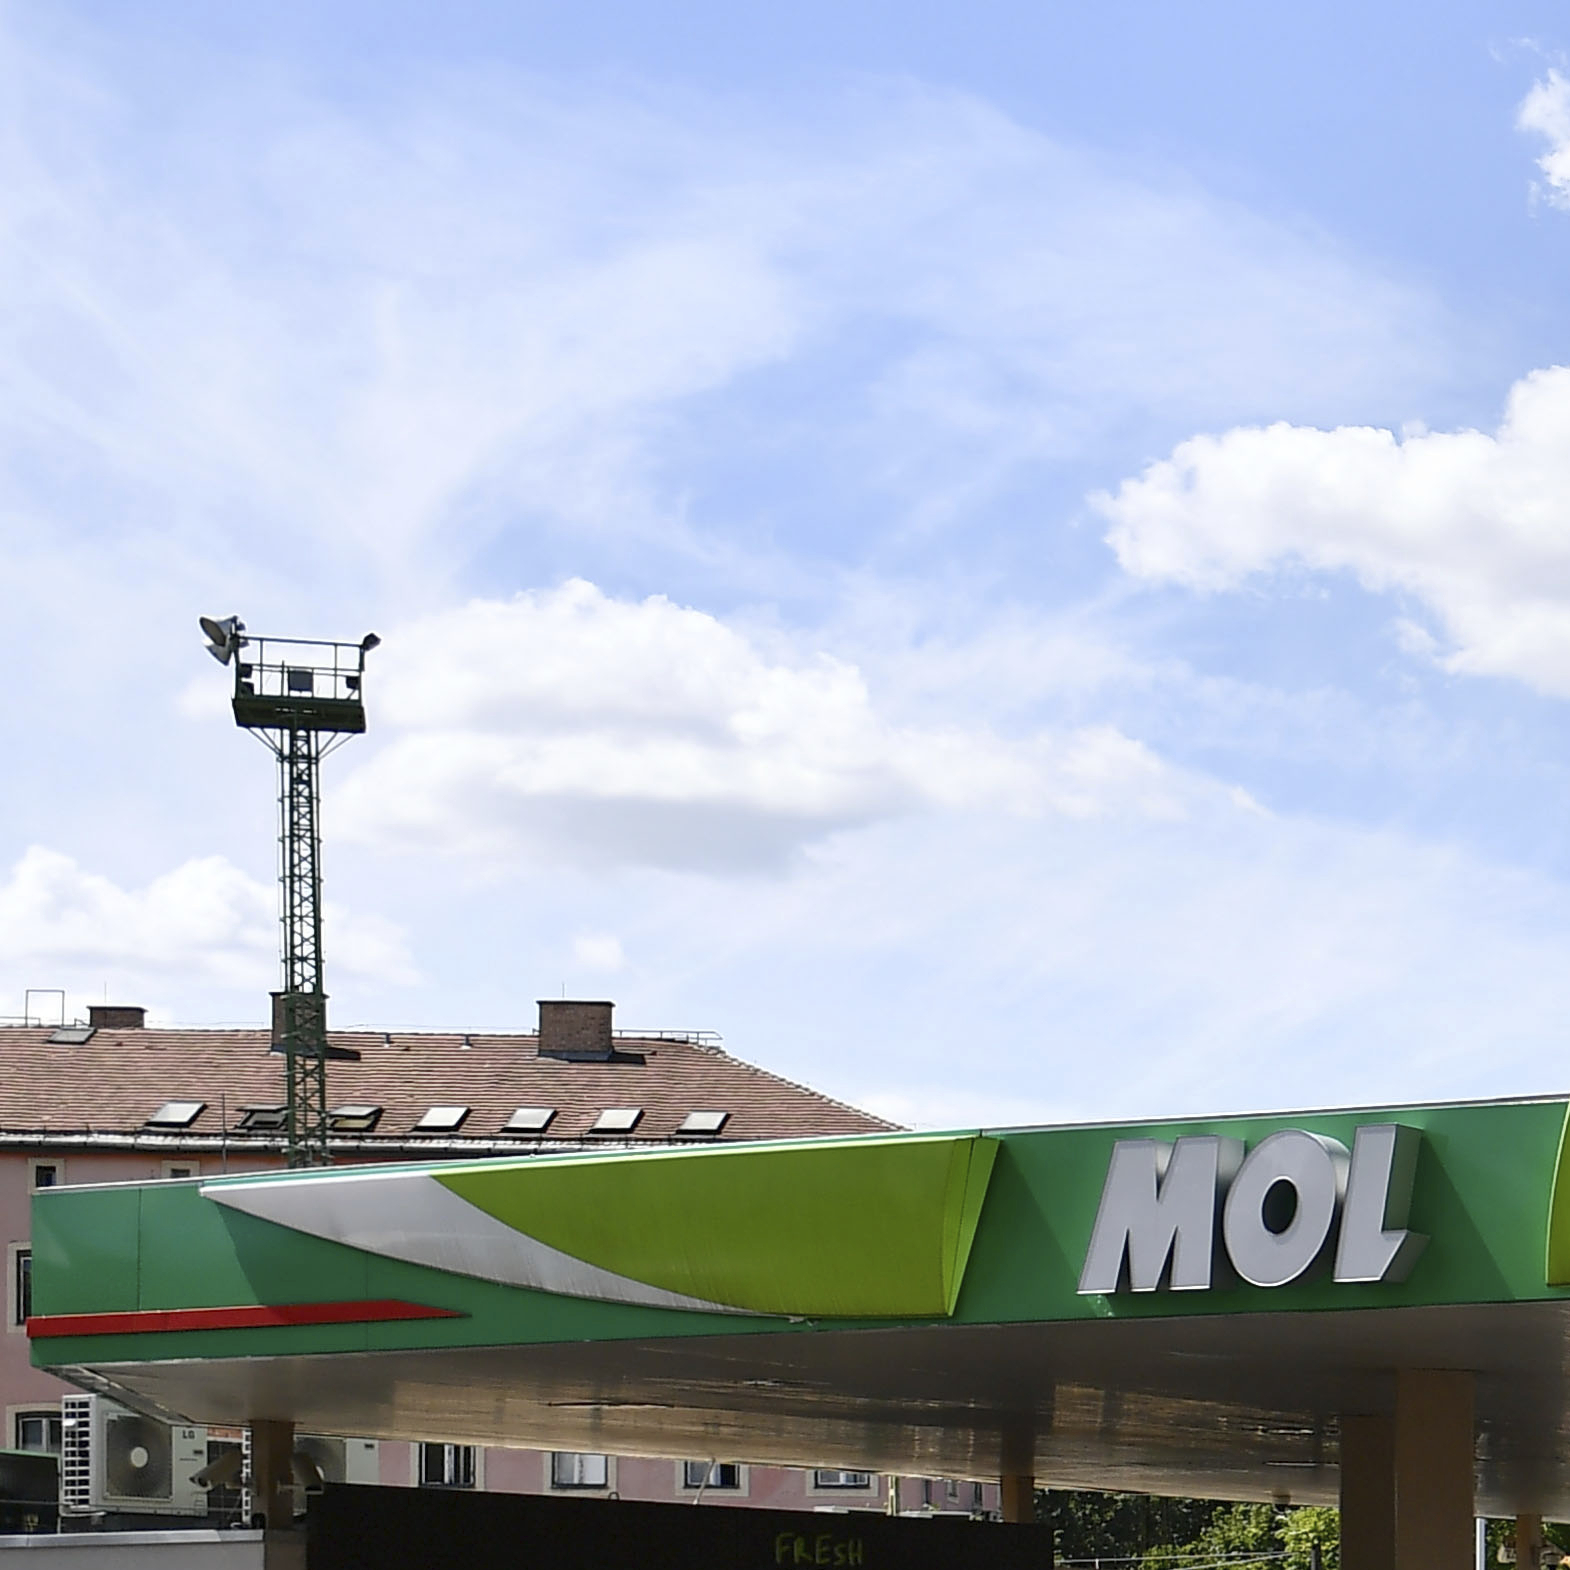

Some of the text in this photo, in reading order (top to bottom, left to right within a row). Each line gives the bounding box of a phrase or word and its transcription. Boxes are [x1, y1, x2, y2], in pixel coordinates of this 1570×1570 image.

[1076, 1123, 1430, 1295] MOL
[182, 1430, 195, 1439] LG
[775, 1531, 863, 1566] FRESH
